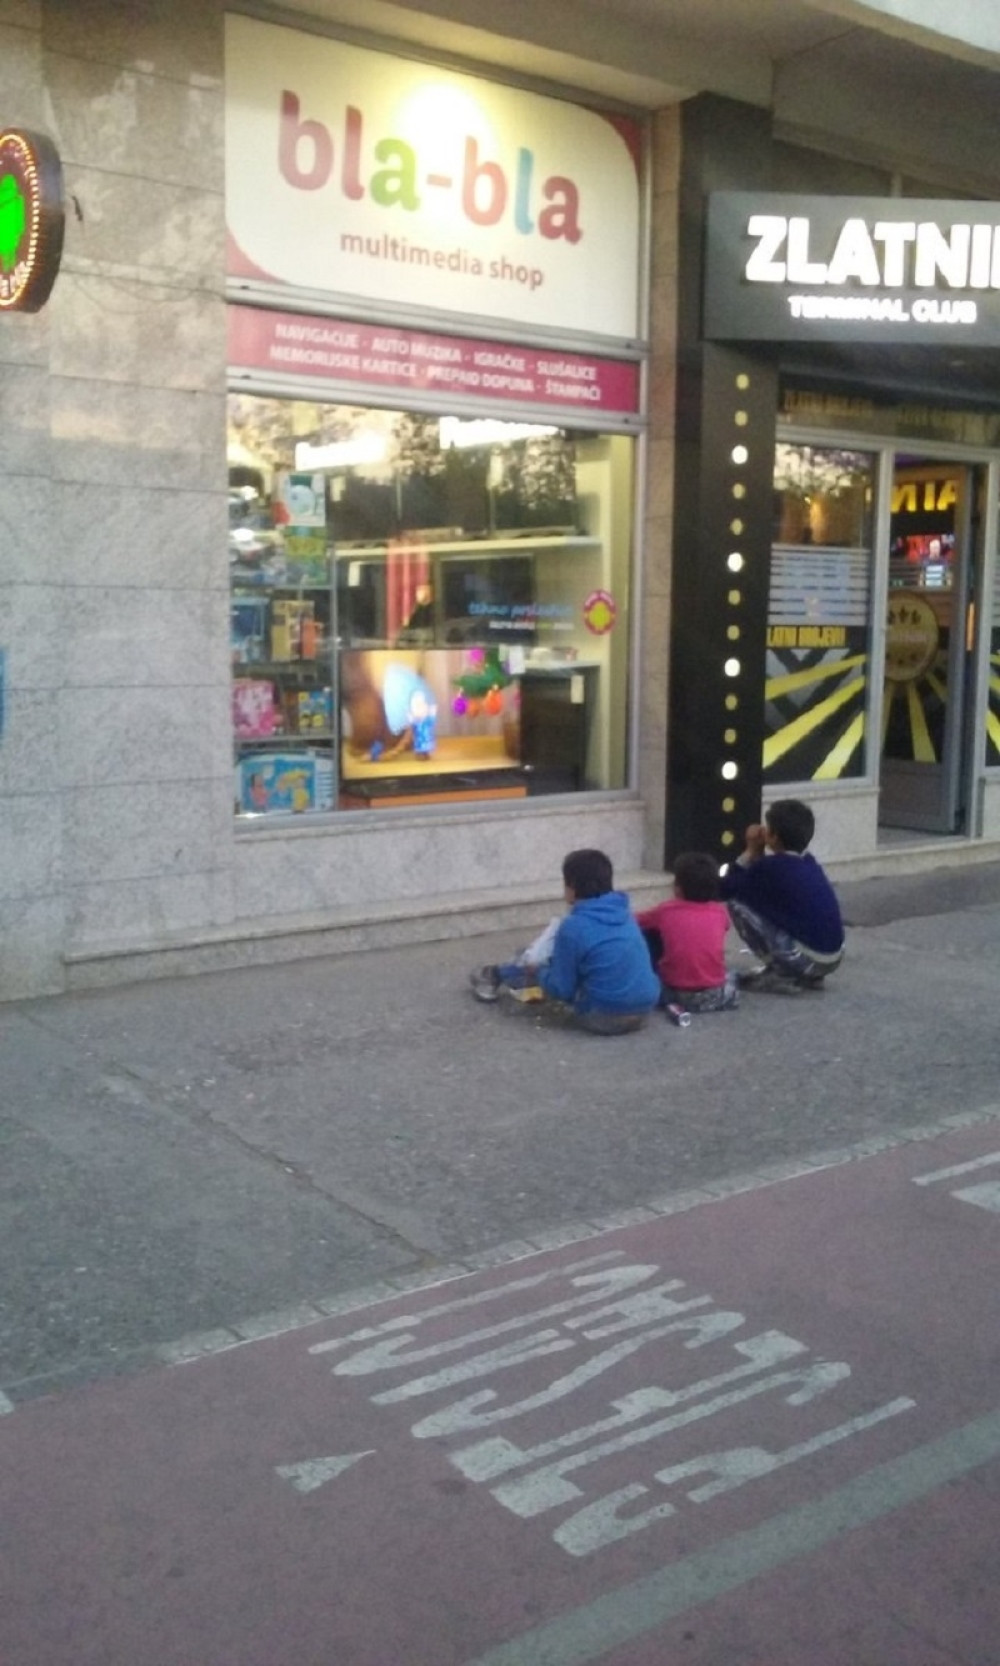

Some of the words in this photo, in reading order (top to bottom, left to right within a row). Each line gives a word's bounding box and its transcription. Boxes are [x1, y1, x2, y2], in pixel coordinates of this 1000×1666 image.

[278, 89, 583, 246] bla-bla
[340, 232, 484, 276] multimedia
[489, 254, 544, 290] shop
[745, 215, 1000, 289] ZLATNI
[911, 298, 977, 324] CLUB
[269, 345, 361, 371] MEMORIJSKE
[361, 357, 417, 378] KARTICE
[427, 364, 480, 386] PREPAID
[482, 372, 535, 392] DOPUNA
[275, 323, 360, 349] NAVIGACIJE
[371, 337, 410, 355] AUTO
[410, 342, 462, 362] MUZIKA
